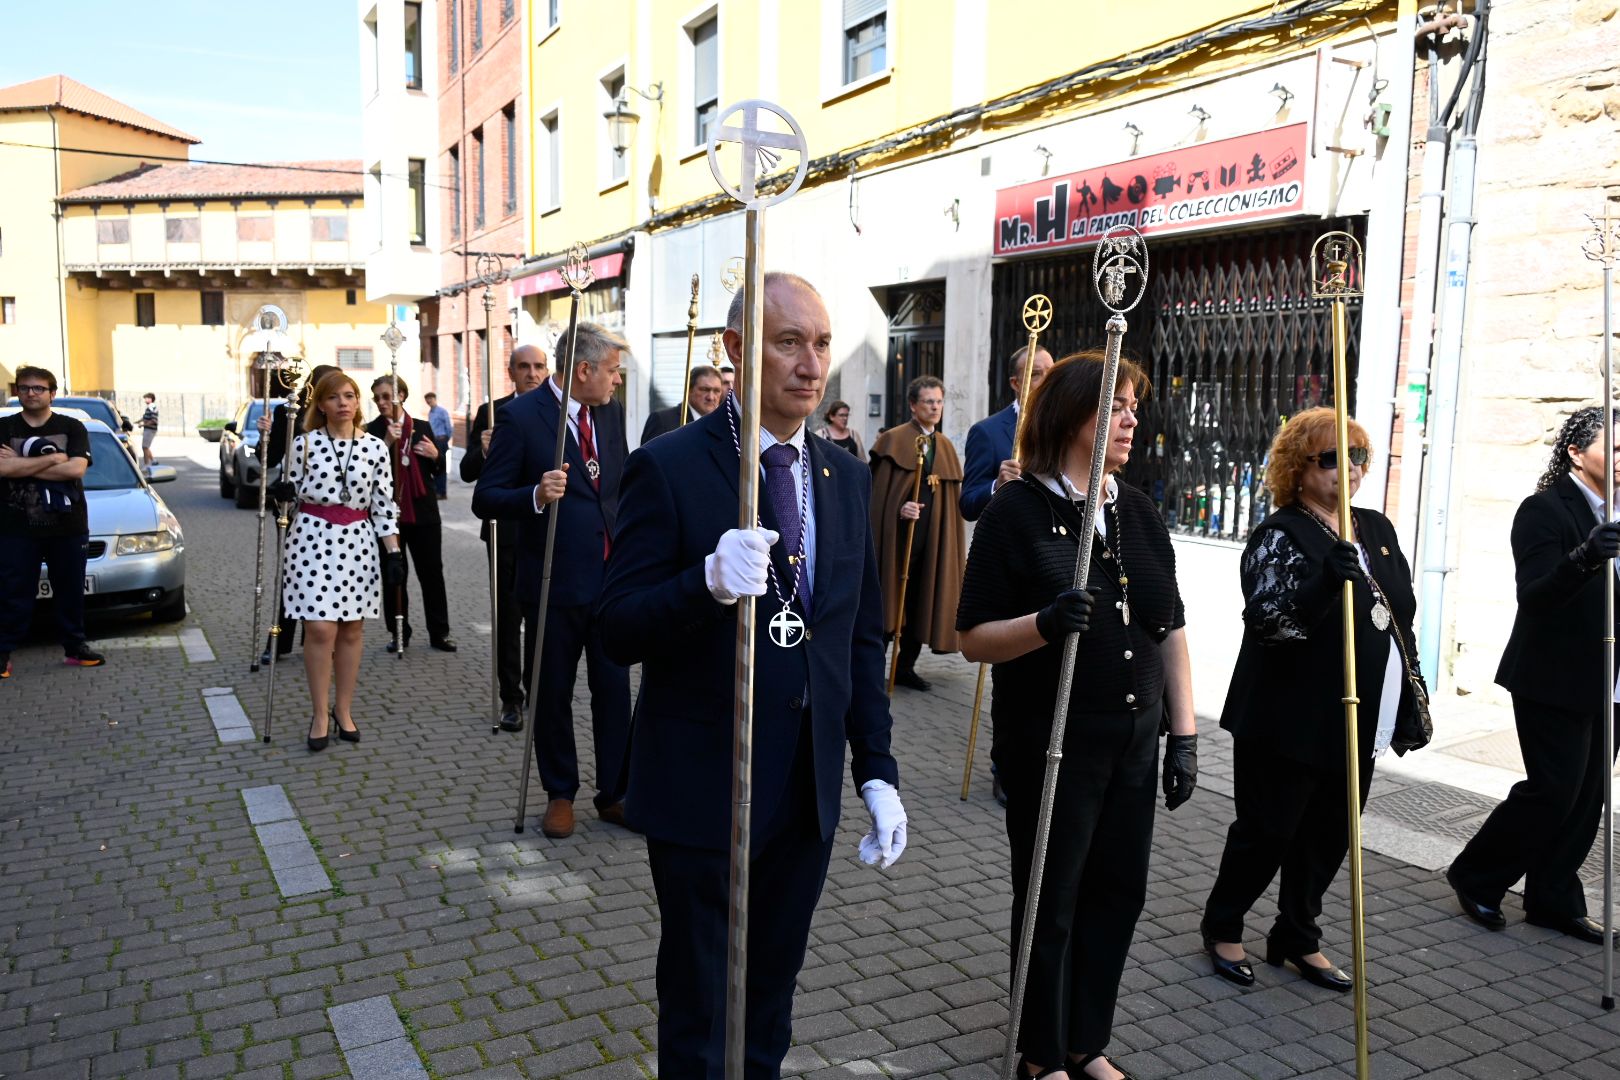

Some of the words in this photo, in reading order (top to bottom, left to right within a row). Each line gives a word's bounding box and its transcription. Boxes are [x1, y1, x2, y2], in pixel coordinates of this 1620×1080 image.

[1072, 220, 1086, 236] LA
[1088, 212, 1137, 237] PARADA
[1140, 207, 1164, 225] DEL
[1169, 183, 1299, 221] COLECCIONISMO
